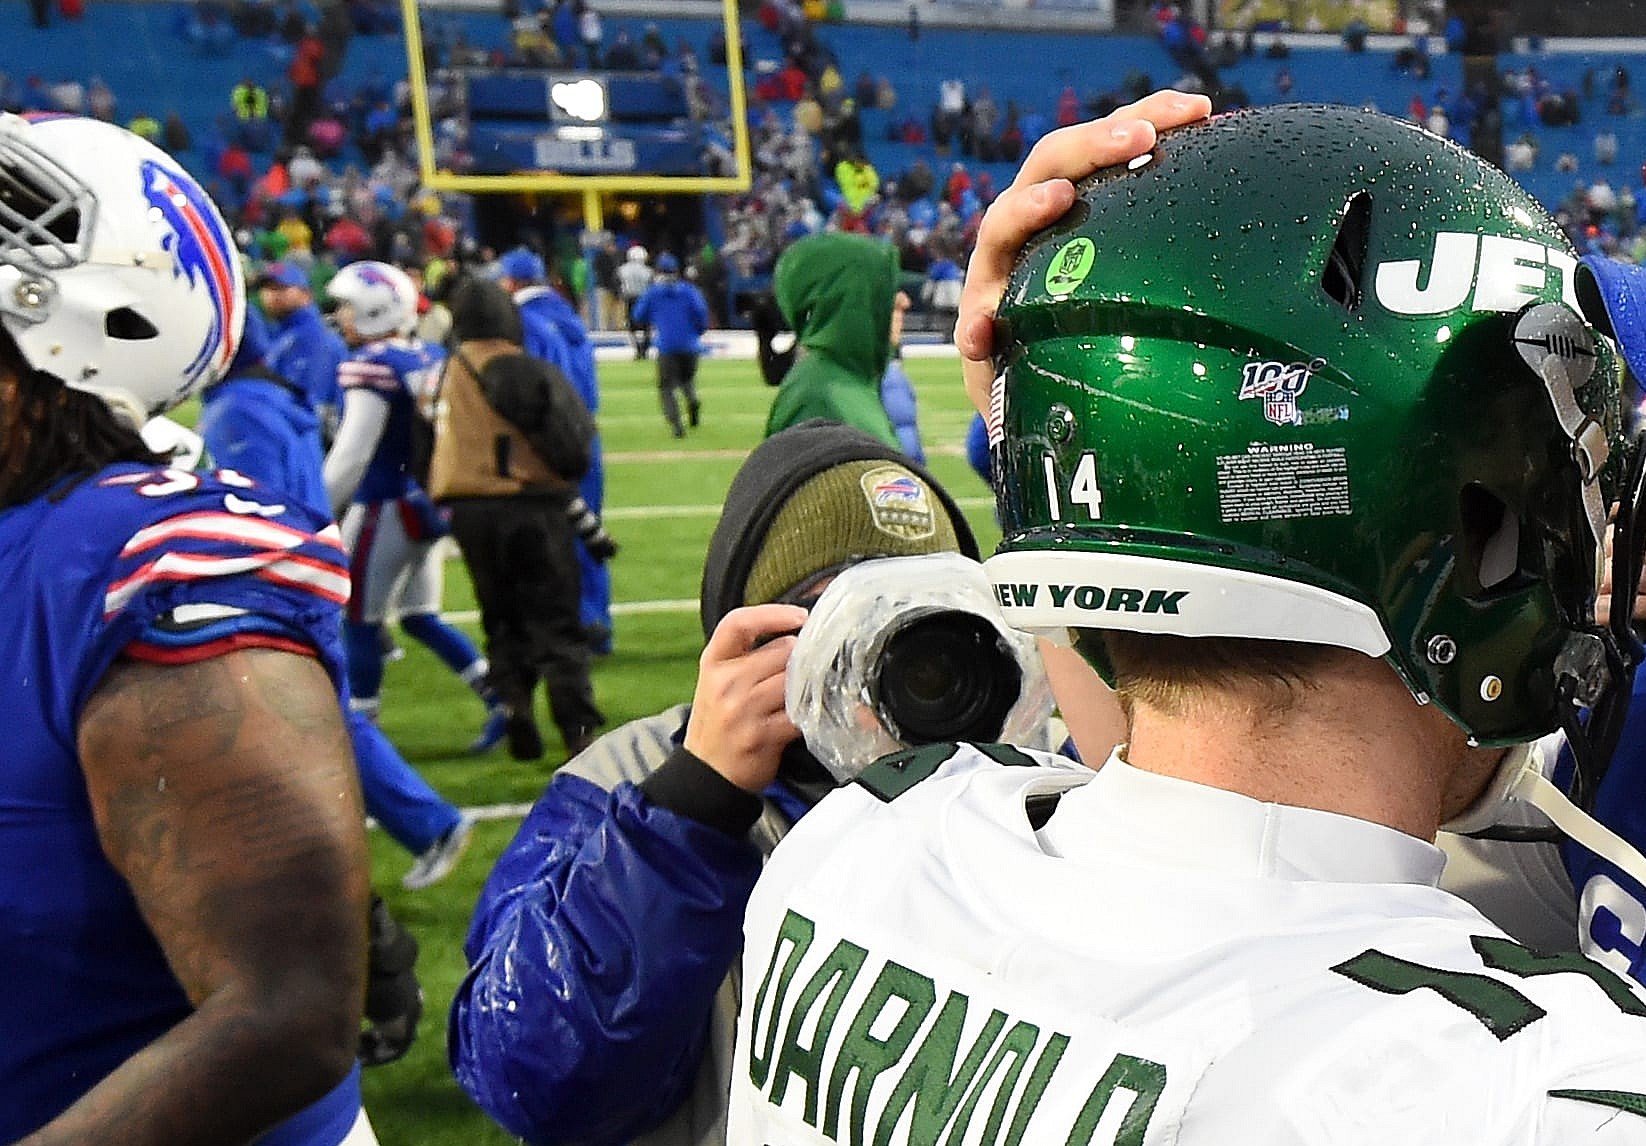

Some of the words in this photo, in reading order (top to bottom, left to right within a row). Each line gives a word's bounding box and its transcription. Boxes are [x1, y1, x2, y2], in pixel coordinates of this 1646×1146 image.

[1268, 403, 1294, 420] NFL
[1247, 443, 1314, 455] WARNING
[1043, 453, 1103, 522] 14
[1047, 584, 1191, 616] YORK
